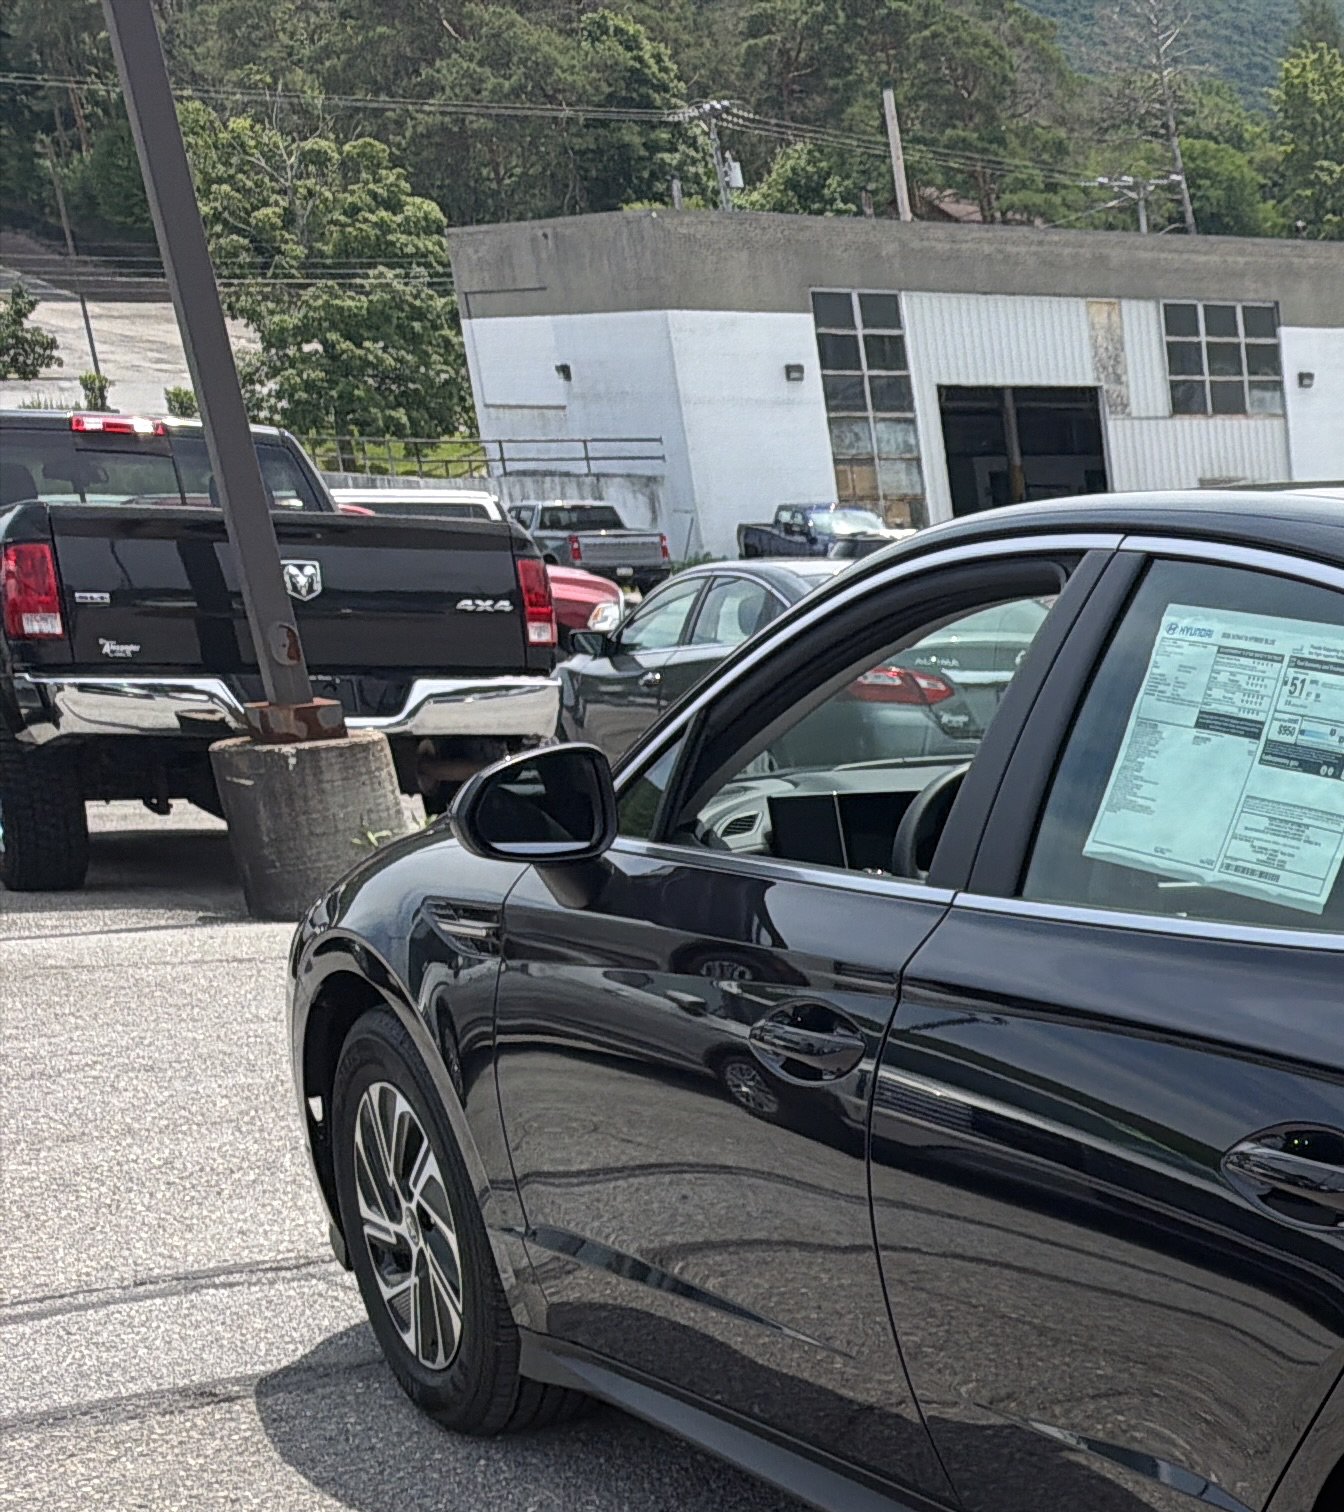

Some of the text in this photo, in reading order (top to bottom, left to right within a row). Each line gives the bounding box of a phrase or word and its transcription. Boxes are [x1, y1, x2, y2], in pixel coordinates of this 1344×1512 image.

[455, 599, 514, 612] 4X4
[1179, 626, 1214, 639] HYUNDAI
[1288, 676, 1307, 698] 51
